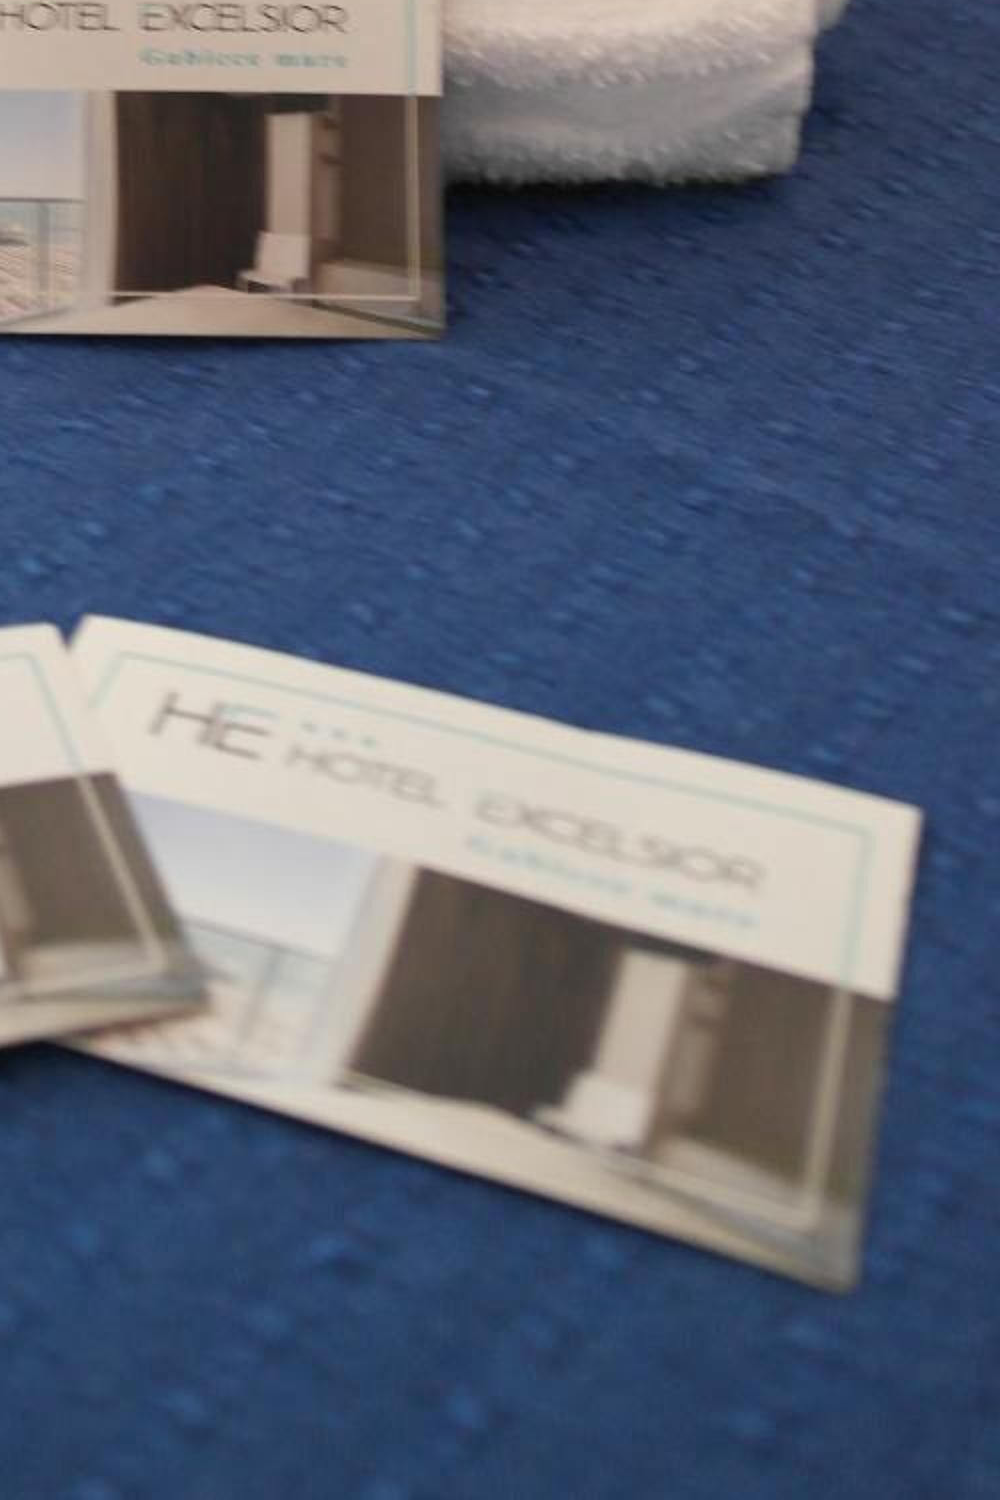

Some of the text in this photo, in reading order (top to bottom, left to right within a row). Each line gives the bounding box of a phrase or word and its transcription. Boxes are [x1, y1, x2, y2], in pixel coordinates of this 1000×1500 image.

[137, 2, 349, 35] EXCELSIOR
[283, 743, 447, 809] HOTEL
[471, 791, 767, 895] EXCELSIOR
